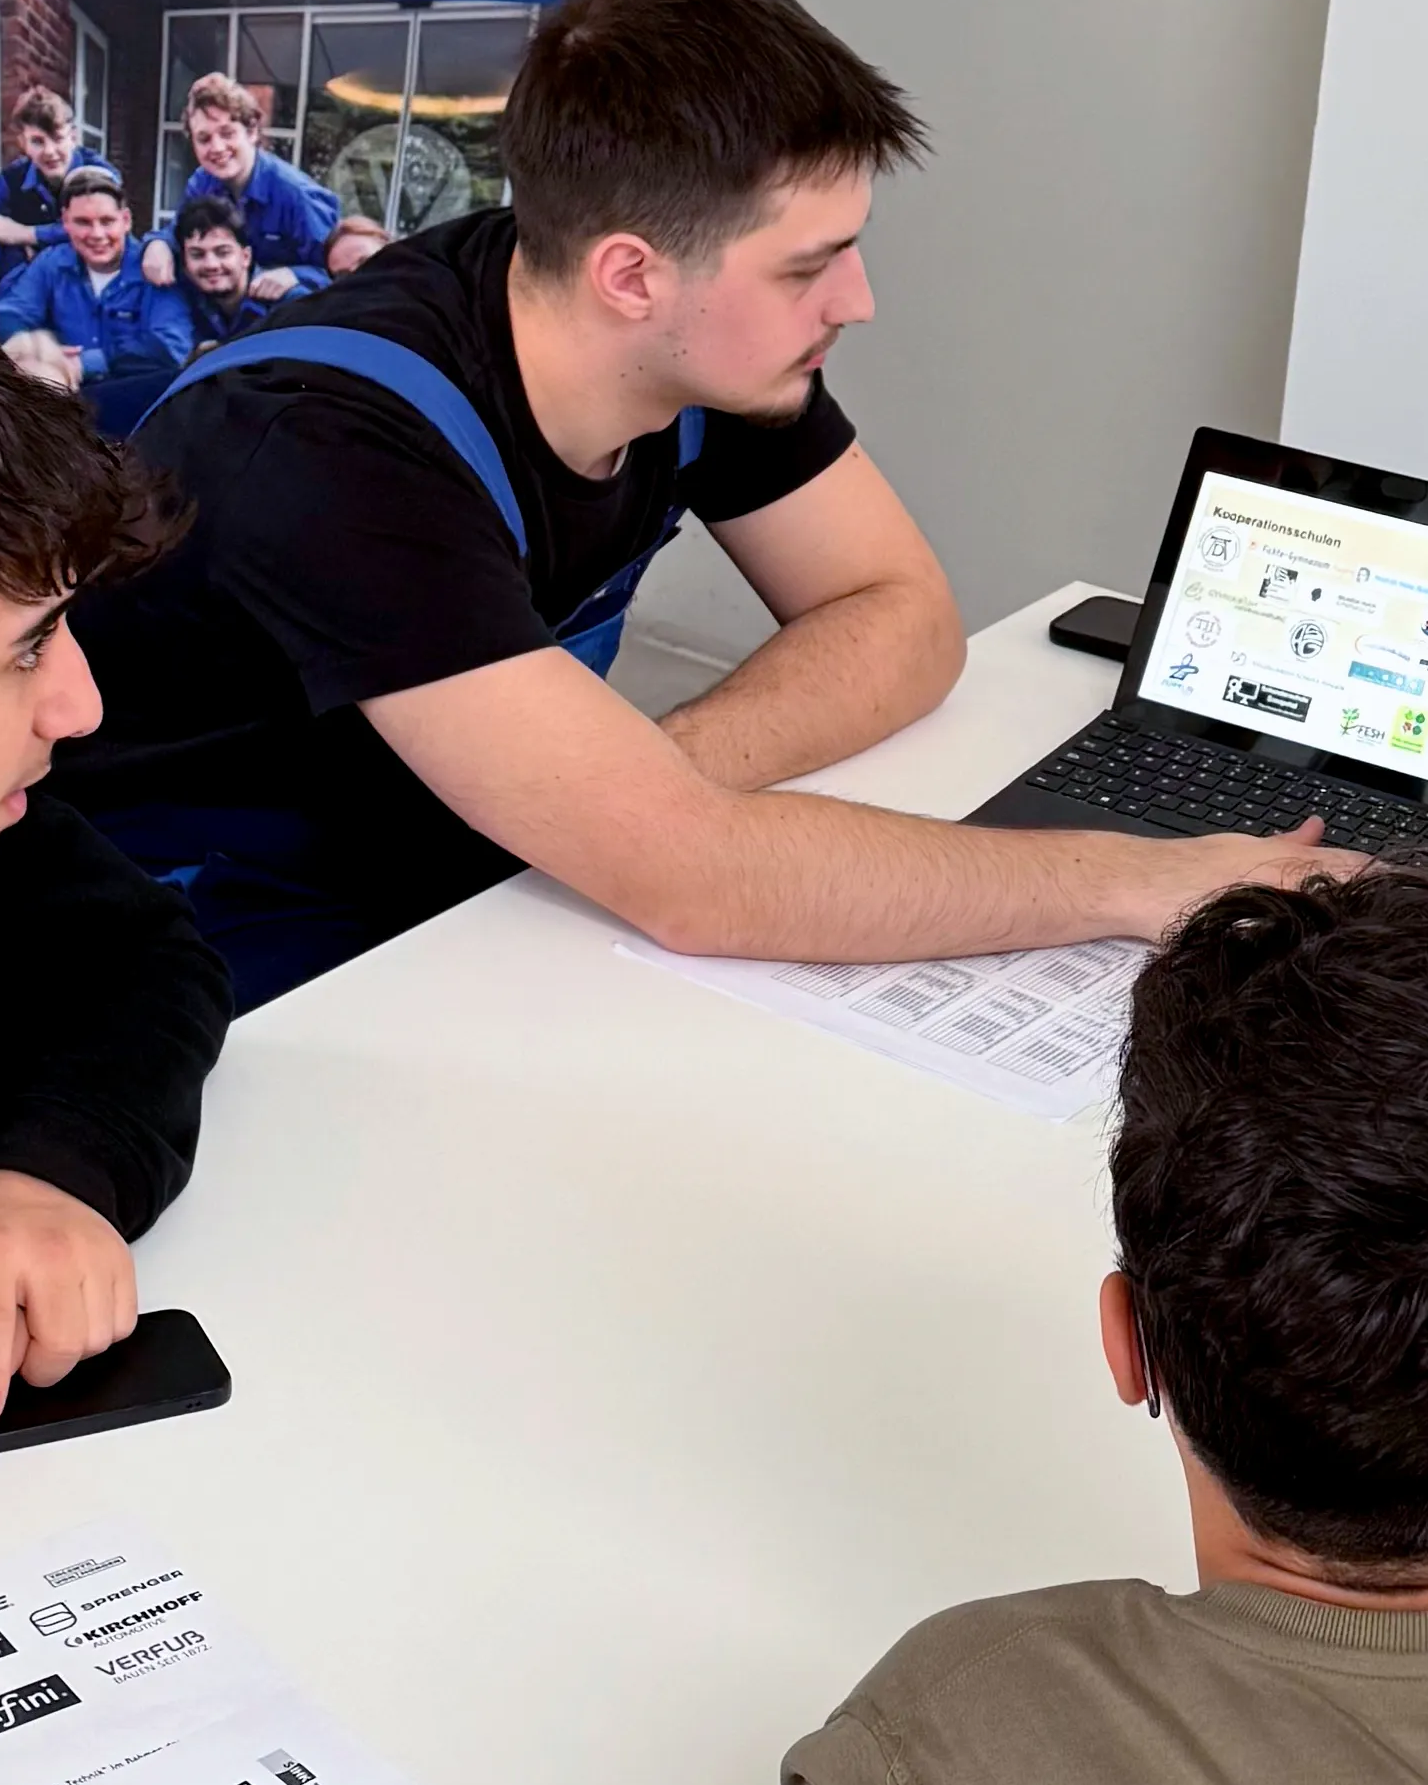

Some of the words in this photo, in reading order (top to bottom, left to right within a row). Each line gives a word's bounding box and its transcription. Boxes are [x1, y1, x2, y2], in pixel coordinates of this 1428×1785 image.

[80, 1570, 184, 1612] SPRENGER
[82, 1591, 204, 1642] KIRCHHOFF
[92, 1616, 167, 1648] AUTOMOTIVE
